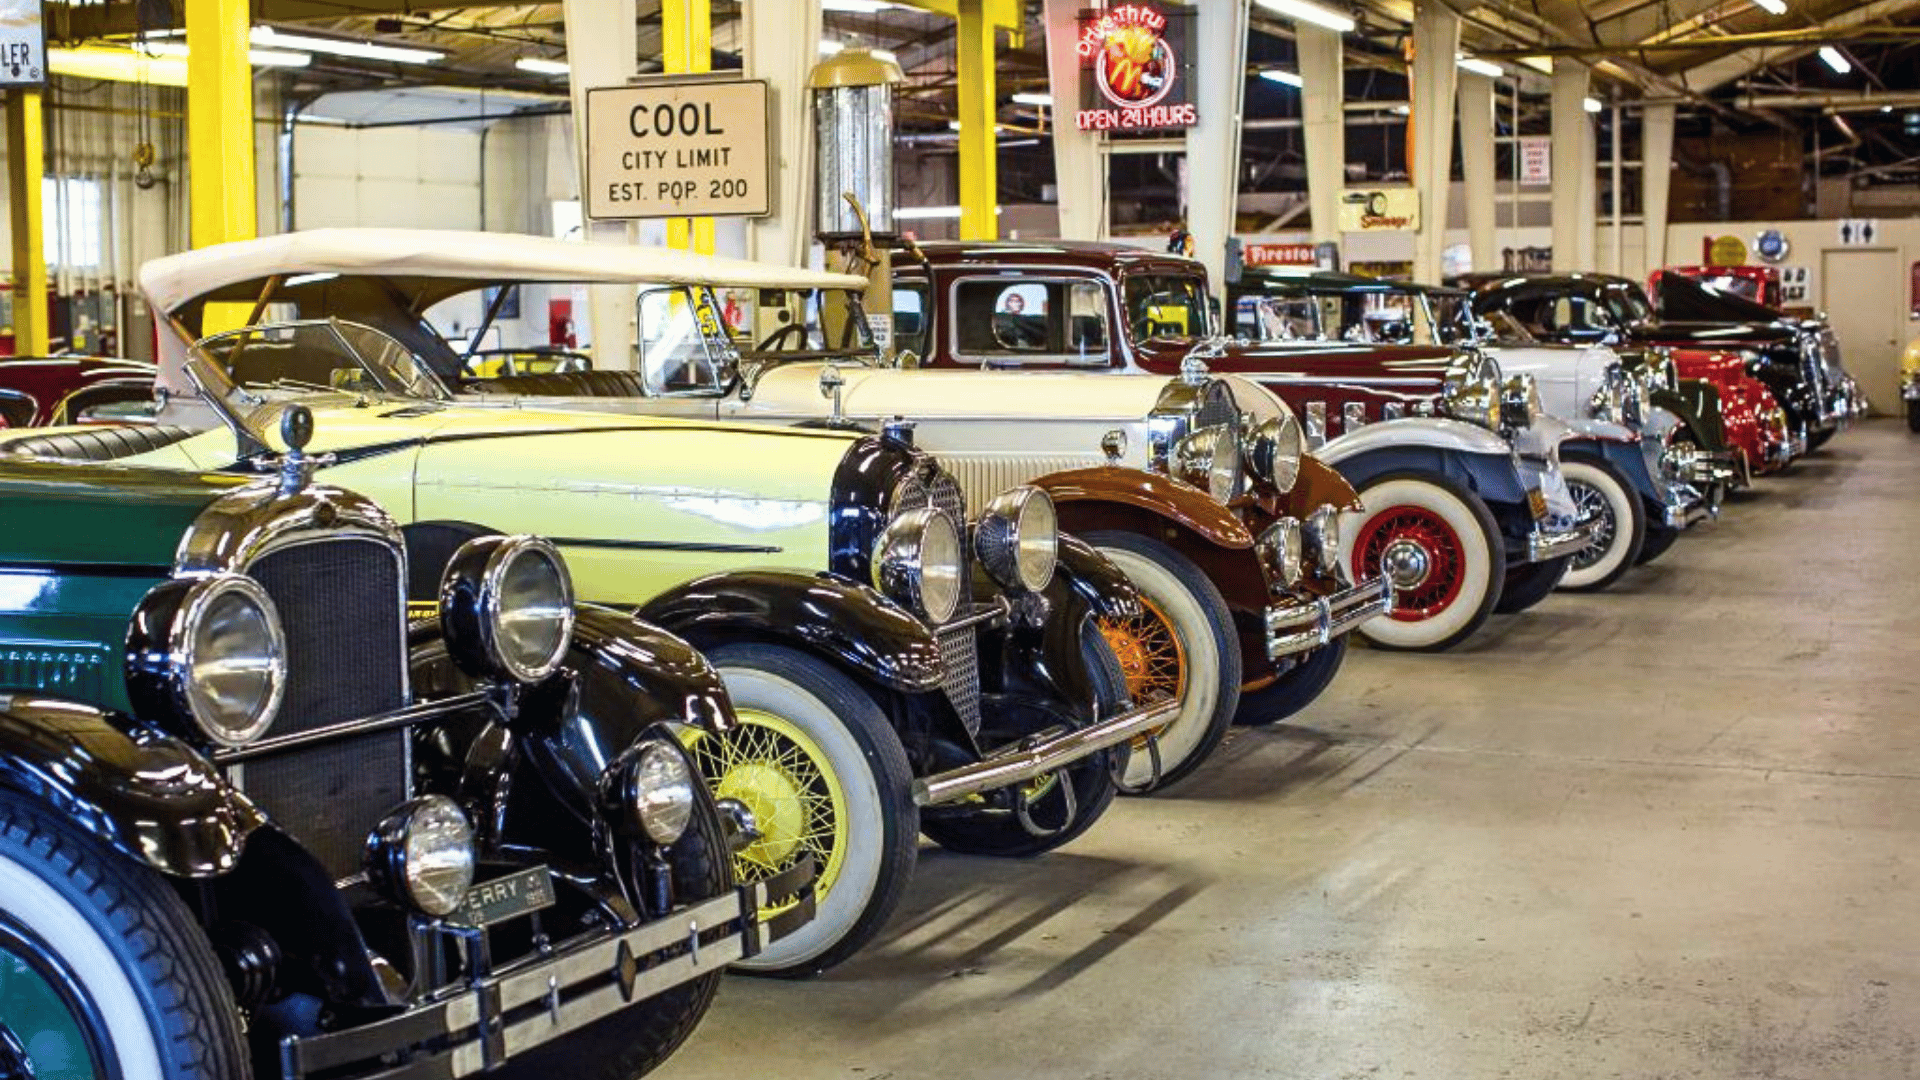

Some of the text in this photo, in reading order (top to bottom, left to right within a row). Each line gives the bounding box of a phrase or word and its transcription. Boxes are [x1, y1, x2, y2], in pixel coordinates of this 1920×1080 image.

[629, 102, 725, 138] COOL
[1075, 103, 1197, 129] OPEN 24 HOURS
[622, 146, 732, 170] CITY LIMIT
[608, 178, 748, 202] EST. POP. 200
